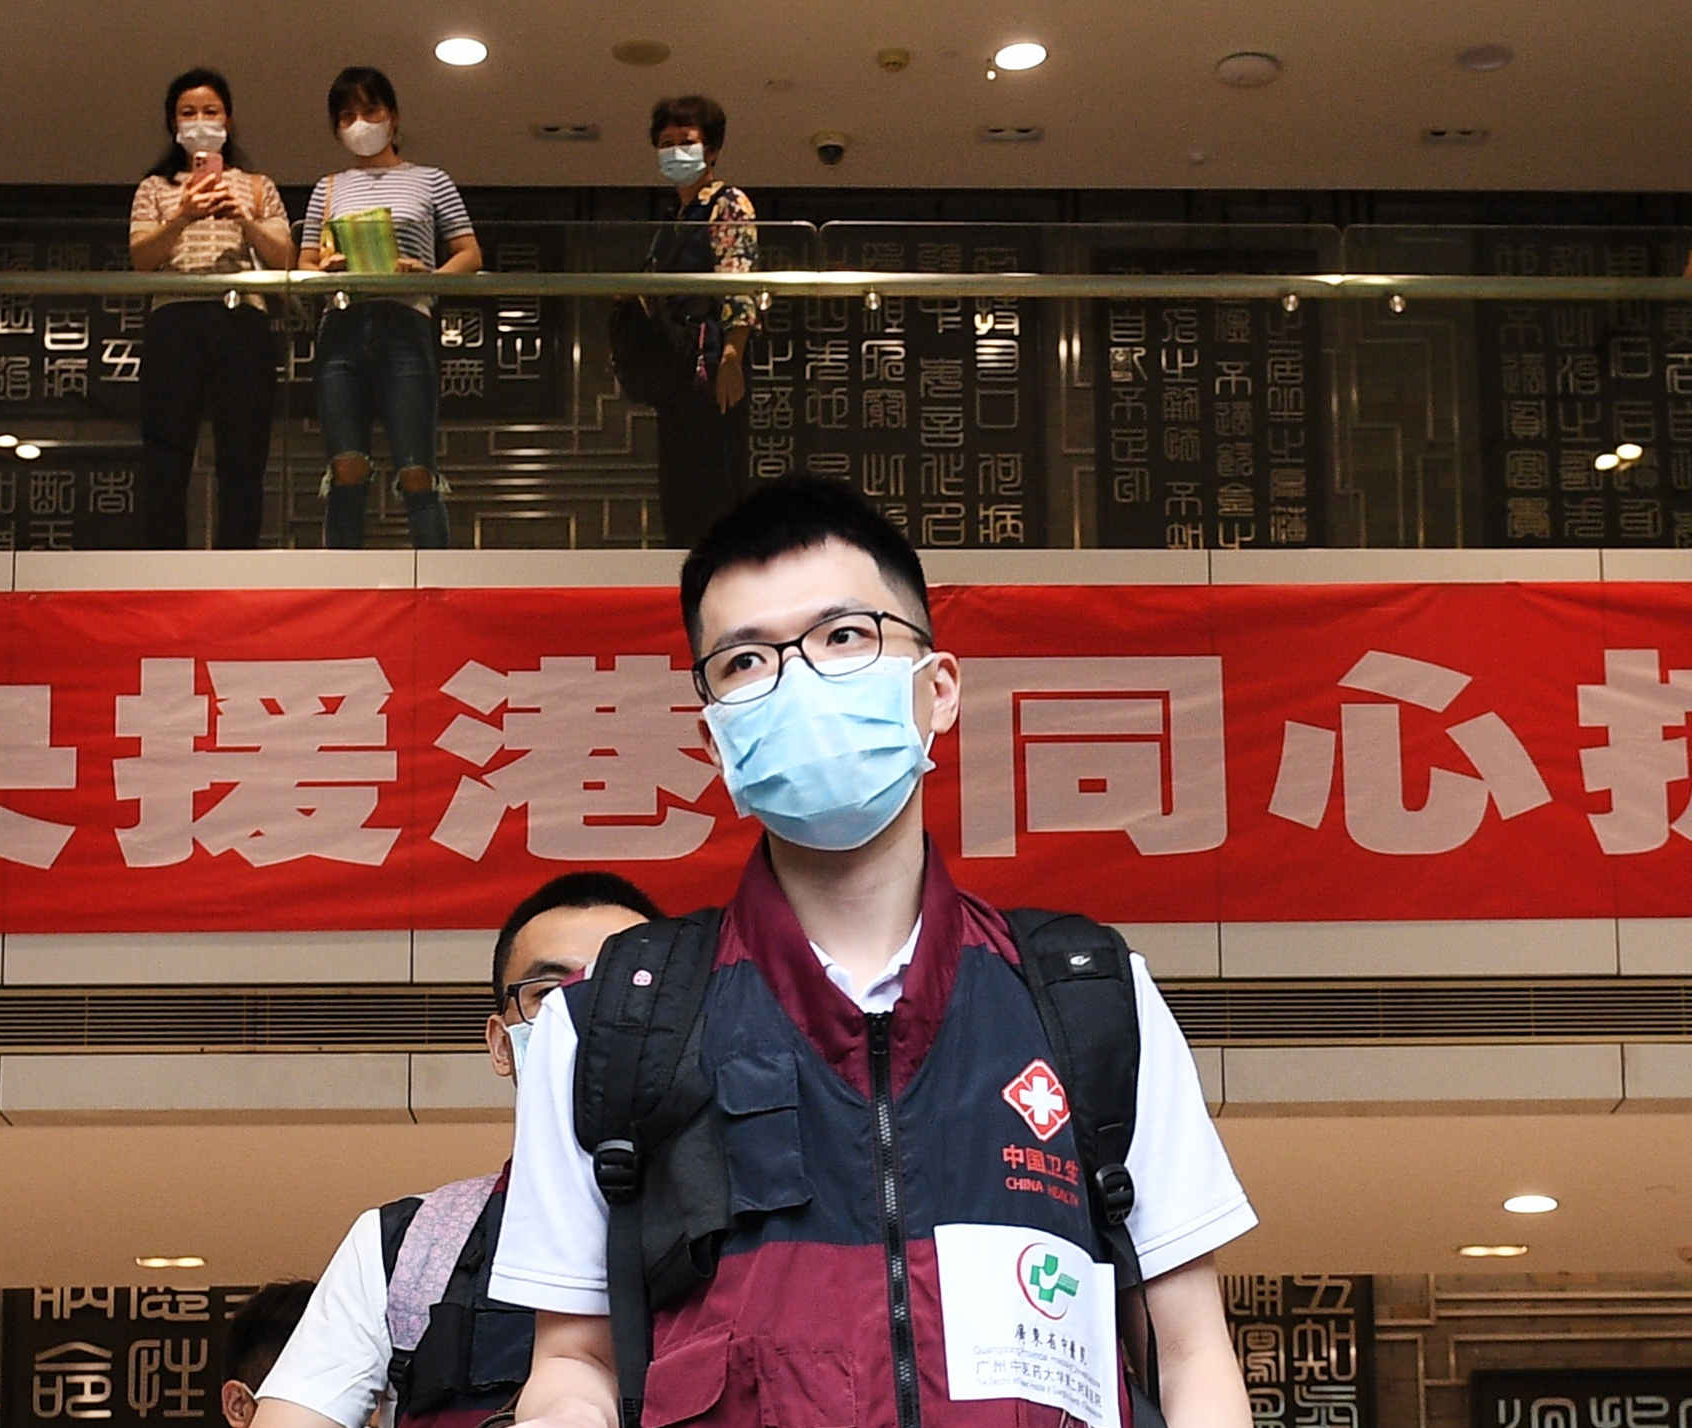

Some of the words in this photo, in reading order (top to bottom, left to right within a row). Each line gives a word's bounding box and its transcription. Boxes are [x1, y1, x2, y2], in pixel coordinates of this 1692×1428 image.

[1002, 1143, 1080, 1186] 中国卫生
[1005, 1176, 1044, 1193] CHINA
